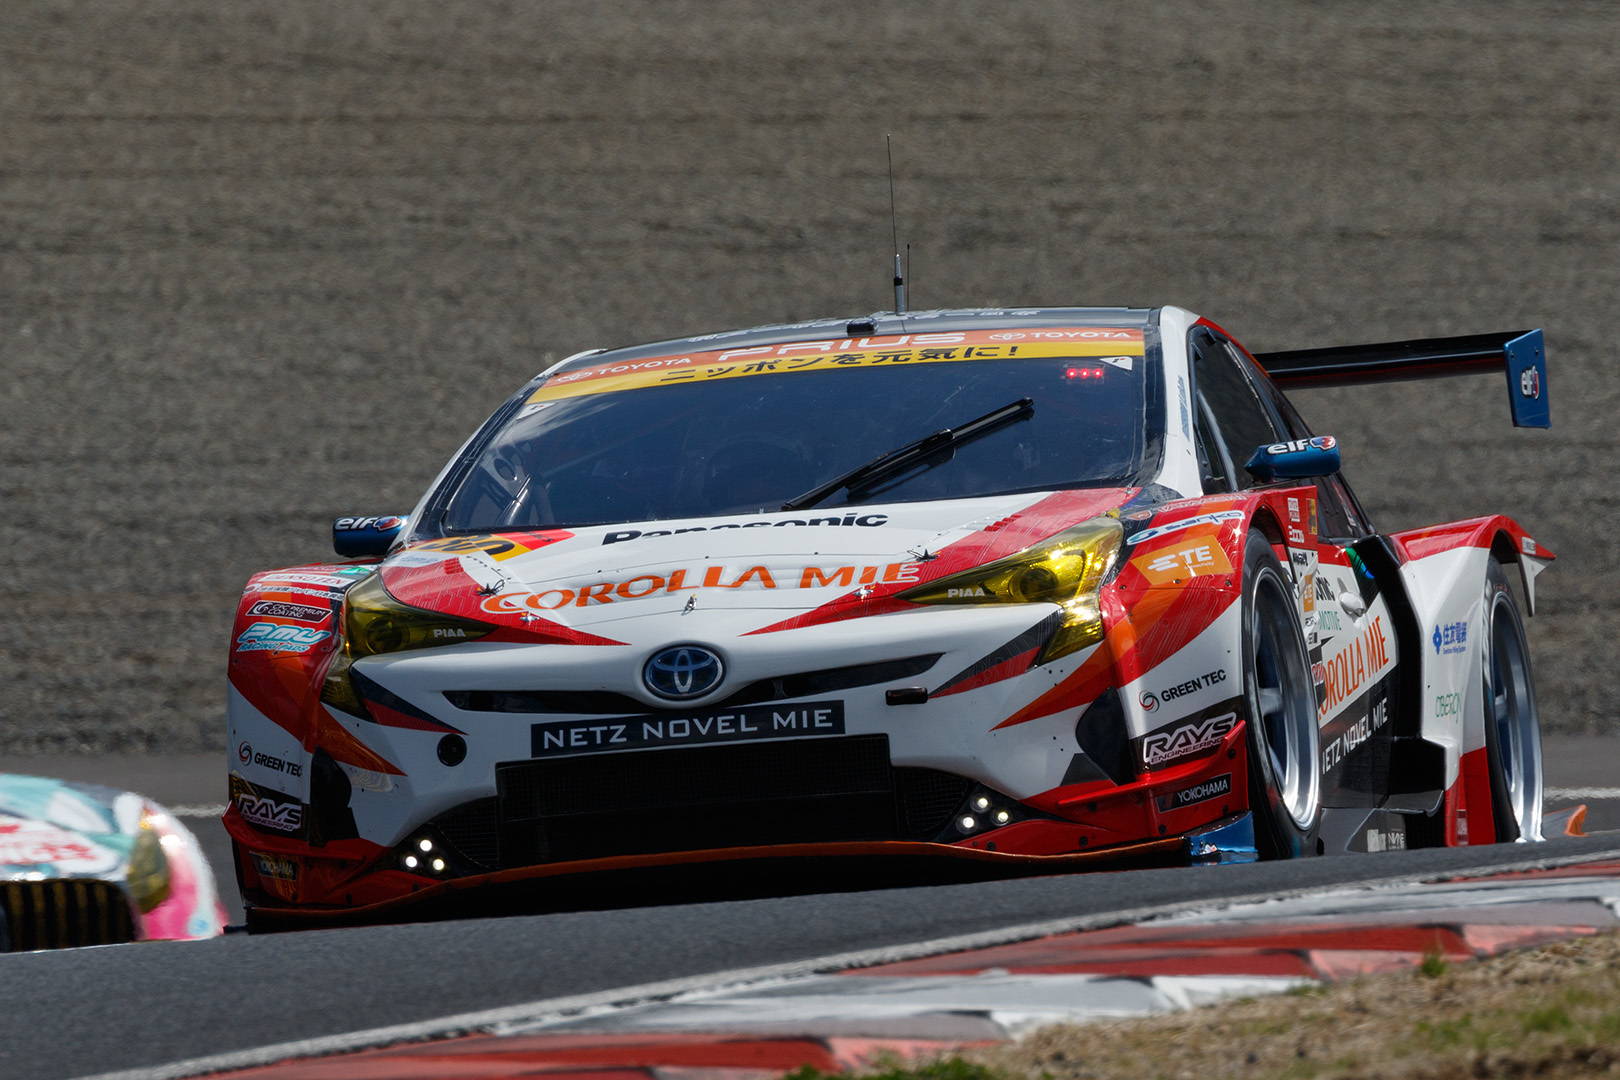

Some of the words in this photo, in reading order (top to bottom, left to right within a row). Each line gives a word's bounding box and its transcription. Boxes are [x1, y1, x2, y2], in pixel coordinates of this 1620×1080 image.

[717, 332, 966, 361] PRIUS
[1030, 331, 1131, 340] TOYOTA
[598, 357, 691, 376] TOYOTA
[1267, 439, 1308, 454] elf
[334, 516, 375, 531] elf
[1179, 545, 1213, 564] TE
[482, 565, 778, 613] COROLLA
[800, 562, 920, 589] MIE
[947, 588, 985, 598] PIAA
[433, 628, 466, 638] PIAA
[1319, 636, 1365, 720] OROLLA
[1364, 615, 1389, 678] MIE
[1161, 677, 1202, 702] GREEN
[1201, 669, 1226, 687] TEC
[543, 724, 627, 749] NETZ
[642, 714, 758, 740] NOVEL
[772, 709, 833, 730] MIE
[1145, 716, 1233, 758] RAYS
[1343, 713, 1372, 757] NOVEL
[1373, 697, 1388, 732] MIE
[254, 752, 284, 773] GREEN
[286, 761, 303, 778] TEC
[1177, 778, 1228, 803] YOKOHAMA
[240, 797, 301, 826] RAYS
